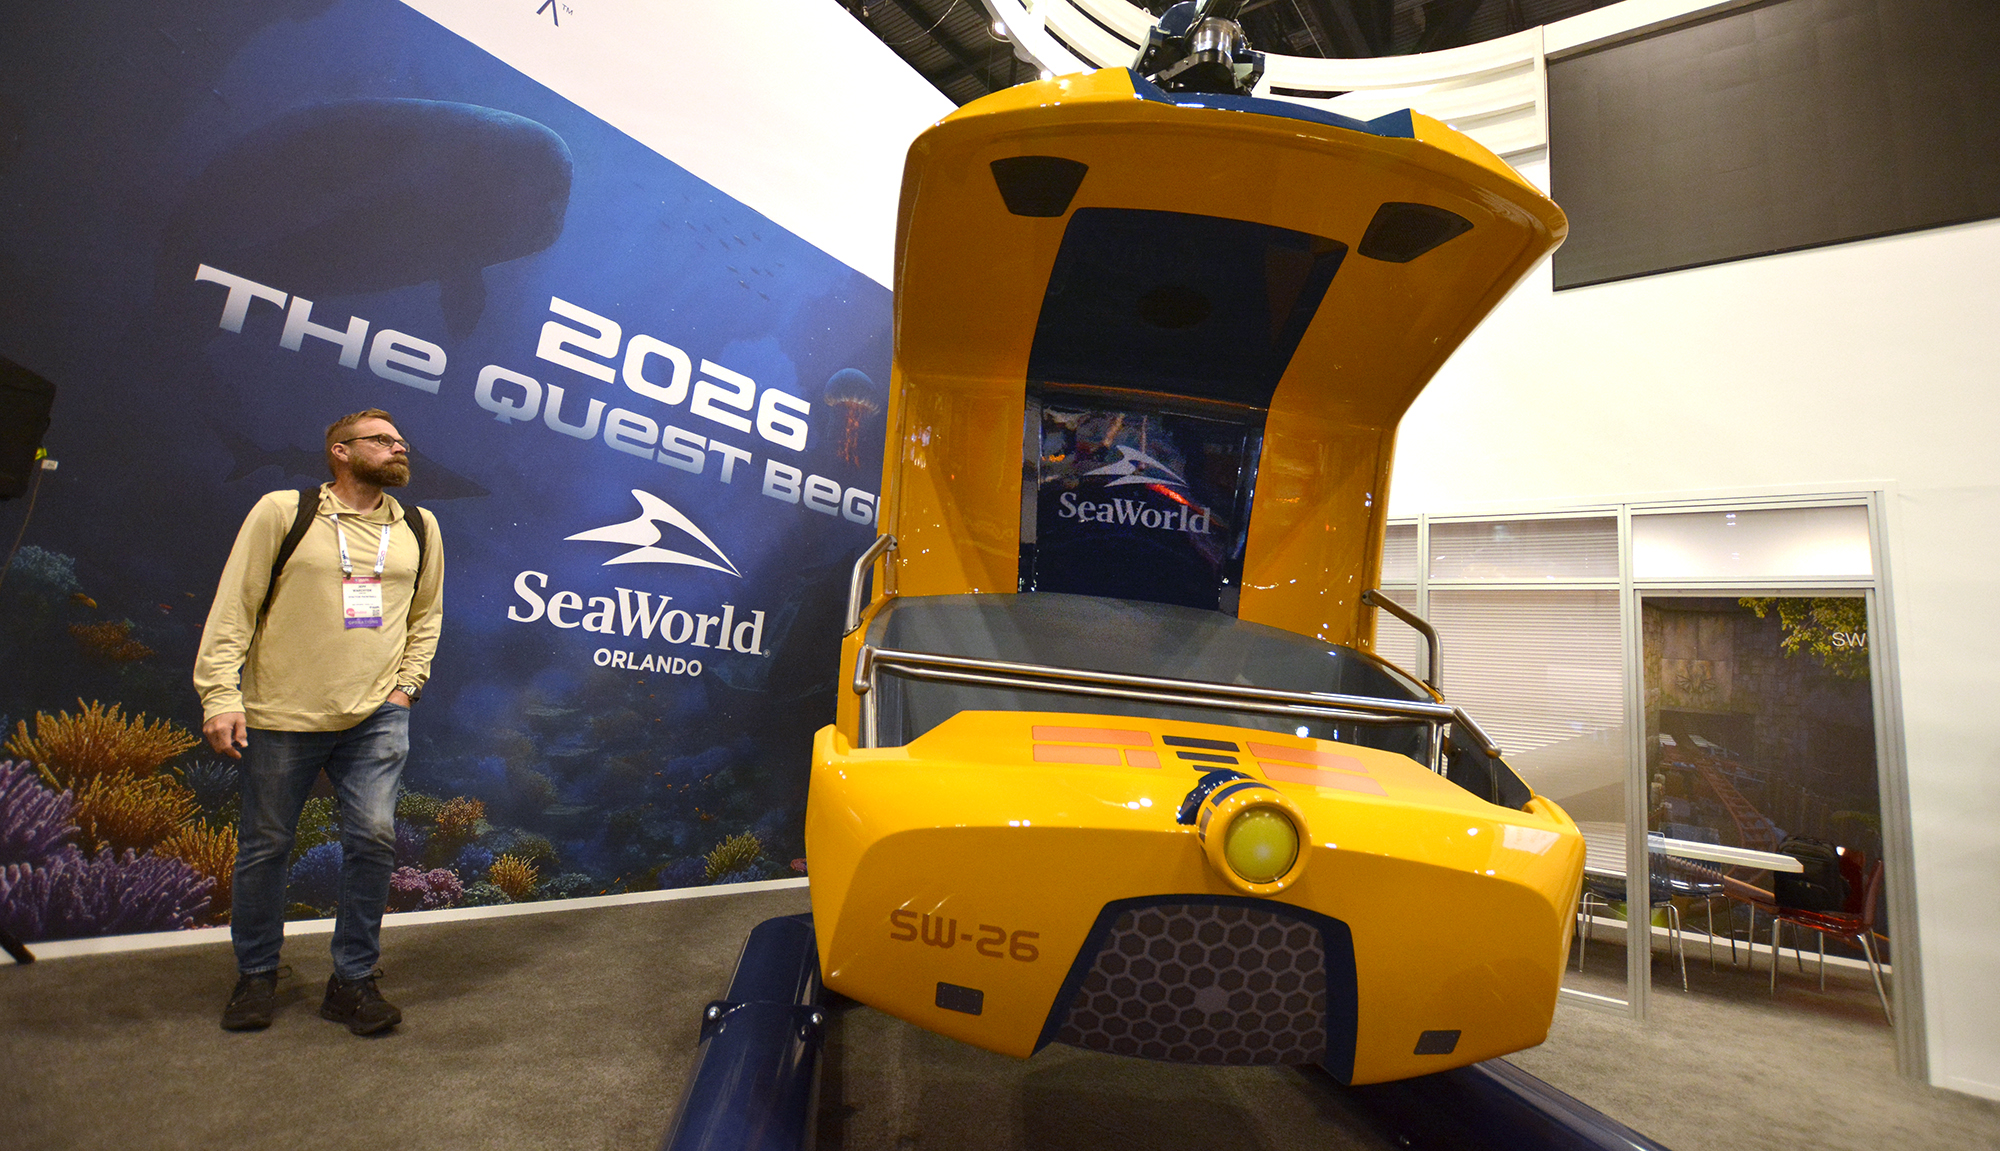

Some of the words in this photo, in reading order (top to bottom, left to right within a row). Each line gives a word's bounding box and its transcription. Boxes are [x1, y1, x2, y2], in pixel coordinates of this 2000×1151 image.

[535, 296, 811, 452] 2026
[1058, 491, 1211, 535] SeaWorld
[1832, 631, 1867, 647] SW
[593, 648, 703, 677] ORLANDO
[890, 909, 1040, 963] SW-26
